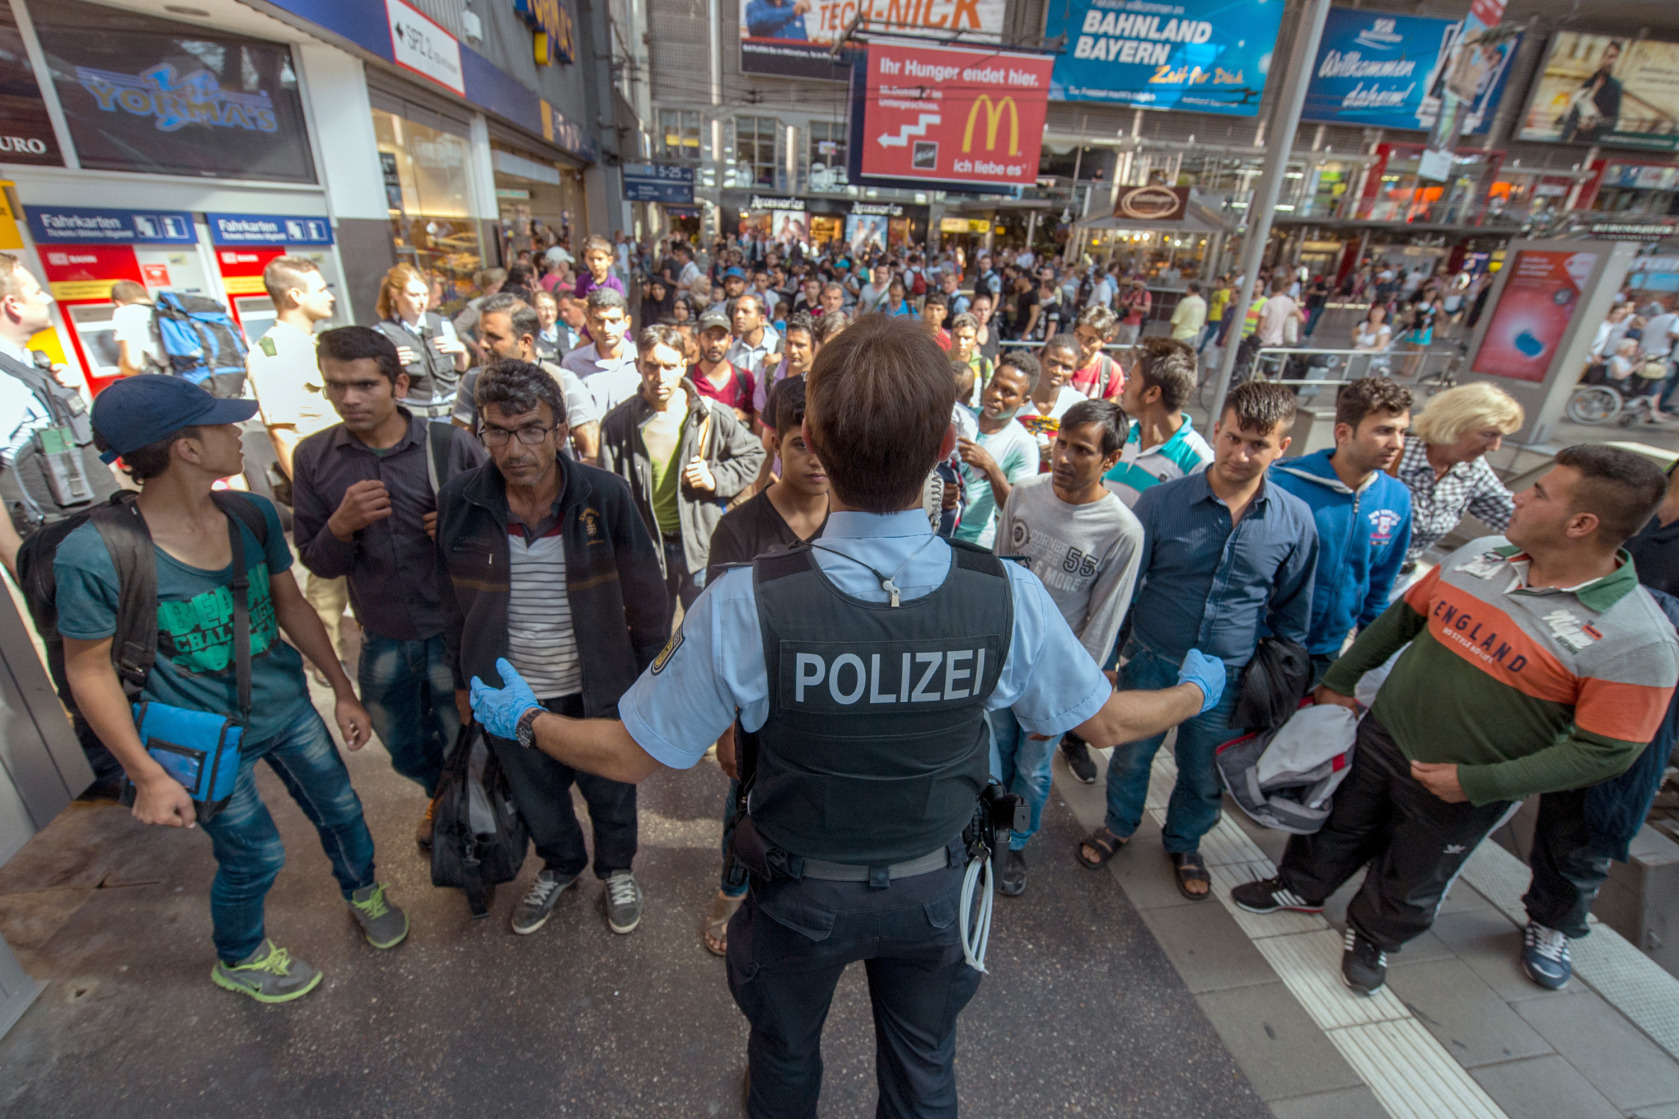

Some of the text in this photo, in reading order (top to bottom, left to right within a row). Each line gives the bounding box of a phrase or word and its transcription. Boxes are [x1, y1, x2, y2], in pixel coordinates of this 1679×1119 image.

[1082, 9, 1213, 44] BAHNLAND
[1074, 35, 1171, 65] BAYERN
[1318, 49, 1416, 78] Willkommen
[880, 57, 1038, 87] Ihr Hunger endet hier.
[1148, 65, 1188, 84] Zeit
[1342, 81, 1416, 108] daheim!
[953, 159, 972, 173] ich
[974, 160, 1004, 174] liebe
[751, 194, 805, 210] Accessorize
[851, 201, 903, 216] Accessorize
[40, 214, 122, 229] Fahrkarten
[218, 219, 278, 232] Fahrkarten
[1030, 529, 1069, 556] CORNER
[1063, 546, 1098, 577] 55
[1043, 566, 1082, 592] MORE
[1433, 600, 1527, 672] ENGLAND
[1451, 632, 1473, 649] STYLE
[796, 648, 985, 705] POLIZEI
